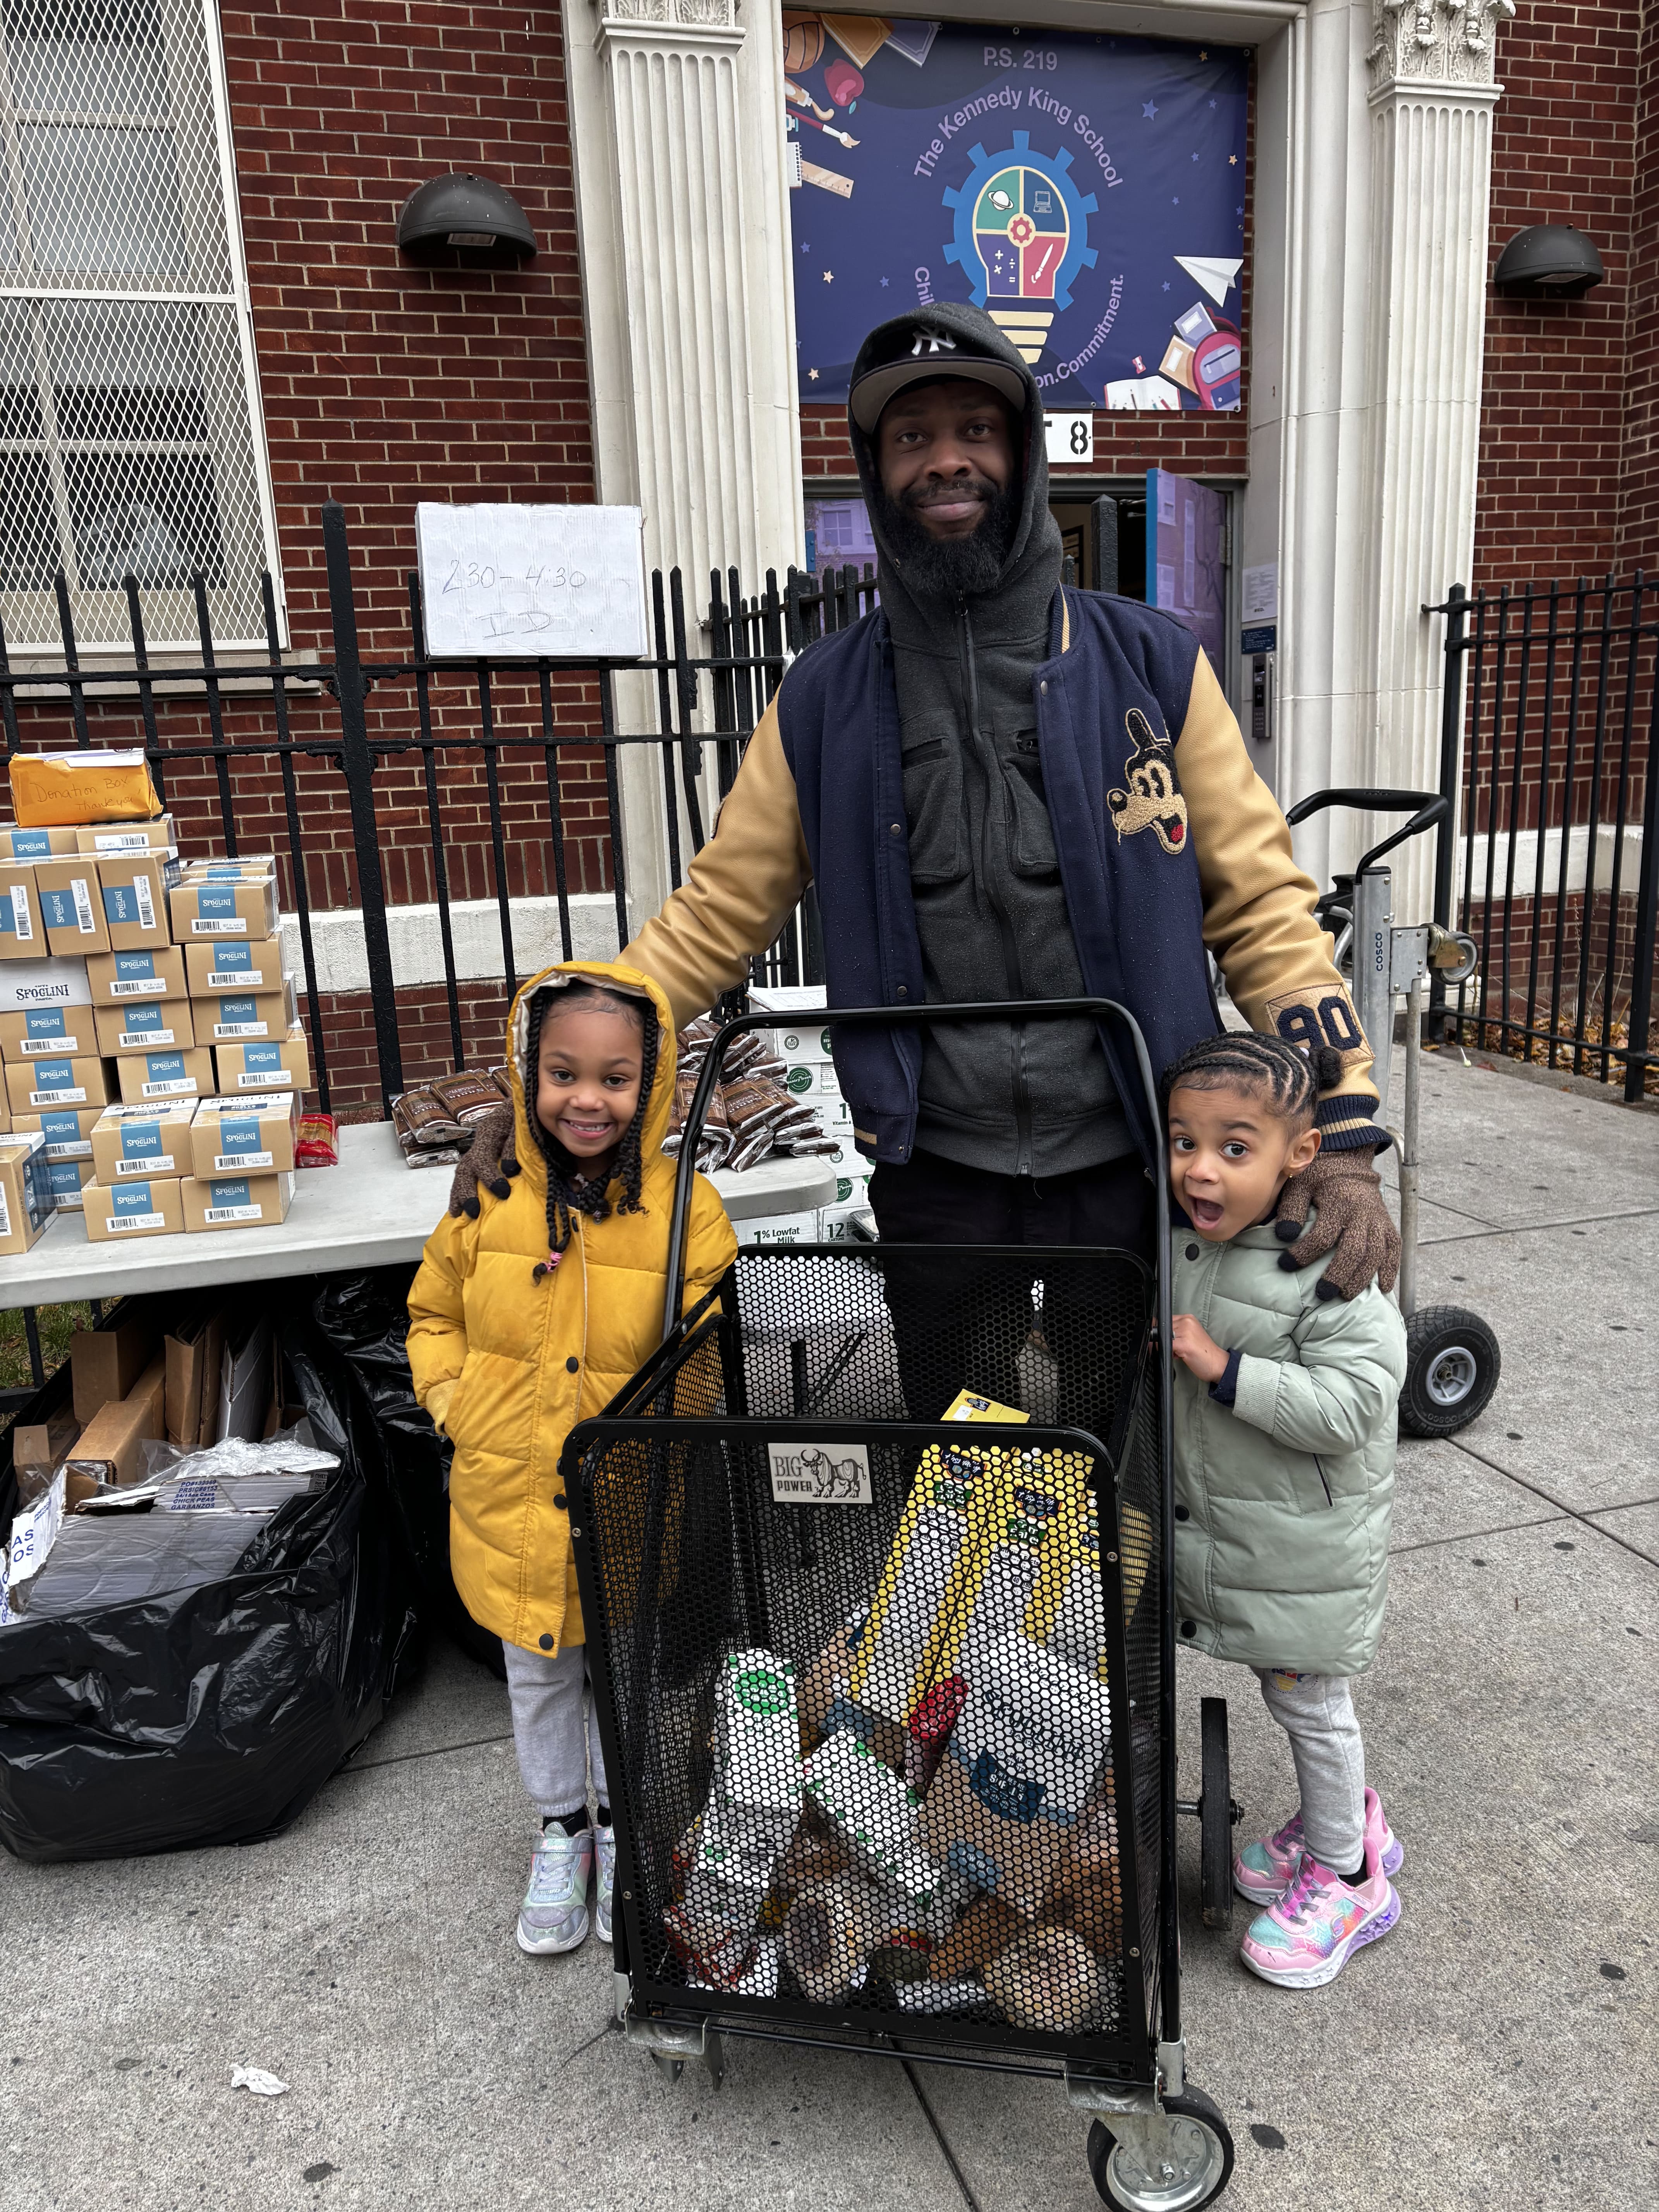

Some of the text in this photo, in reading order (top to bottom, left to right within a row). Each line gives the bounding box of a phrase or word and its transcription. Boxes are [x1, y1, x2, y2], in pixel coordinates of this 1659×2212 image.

[984, 46, 1058, 71] P.S. 219
[914, 85, 1123, 188] The Kennedy King School
[1070, 421, 1088, 455] 8
[526, 564, 586, 588] 4:30
[30, 776, 128, 802] Donation Box
[17, 842, 46, 850] SFOGLINI
[114, 891, 126, 919] SFOGLINI
[203, 899, 231, 907] SFOGLINI
[52, 895, 64, 923] SFOGLINI
[219, 952, 246, 960] SFOGLINI
[1375, 932, 1384, 972] COSCO
[120, 960, 149, 968] SFOGLINI
[16, 984, 70, 1000] SFOGLINI
[129, 1012, 157, 1020] SFOGLINI
[31, 1018, 60, 1027] SFOGLINI
[1276, 995, 1362, 1050] 90
[249, 1052, 276, 1061] SFOGLINI
[152, 1060, 180, 1070] SFOGLINI
[40, 1070, 68, 1079] SFOGLINI
[46, 1123, 75, 1132] SFOGLINI
[127, 1137, 156, 1146] SFOGLINI
[226, 1132, 256, 1142] SFOGLINI
[215, 1185, 245, 1195] SFOGLINI
[117, 1194, 146, 1204] SFOGLINI
[827, 1222, 845, 1238] 12
[754, 1227, 800, 1244] 1% Lowfat
[777, 1235, 795, 1243] Milk
[773, 1456, 803, 1477] BIG
[777, 1480, 812, 1492] POWER
